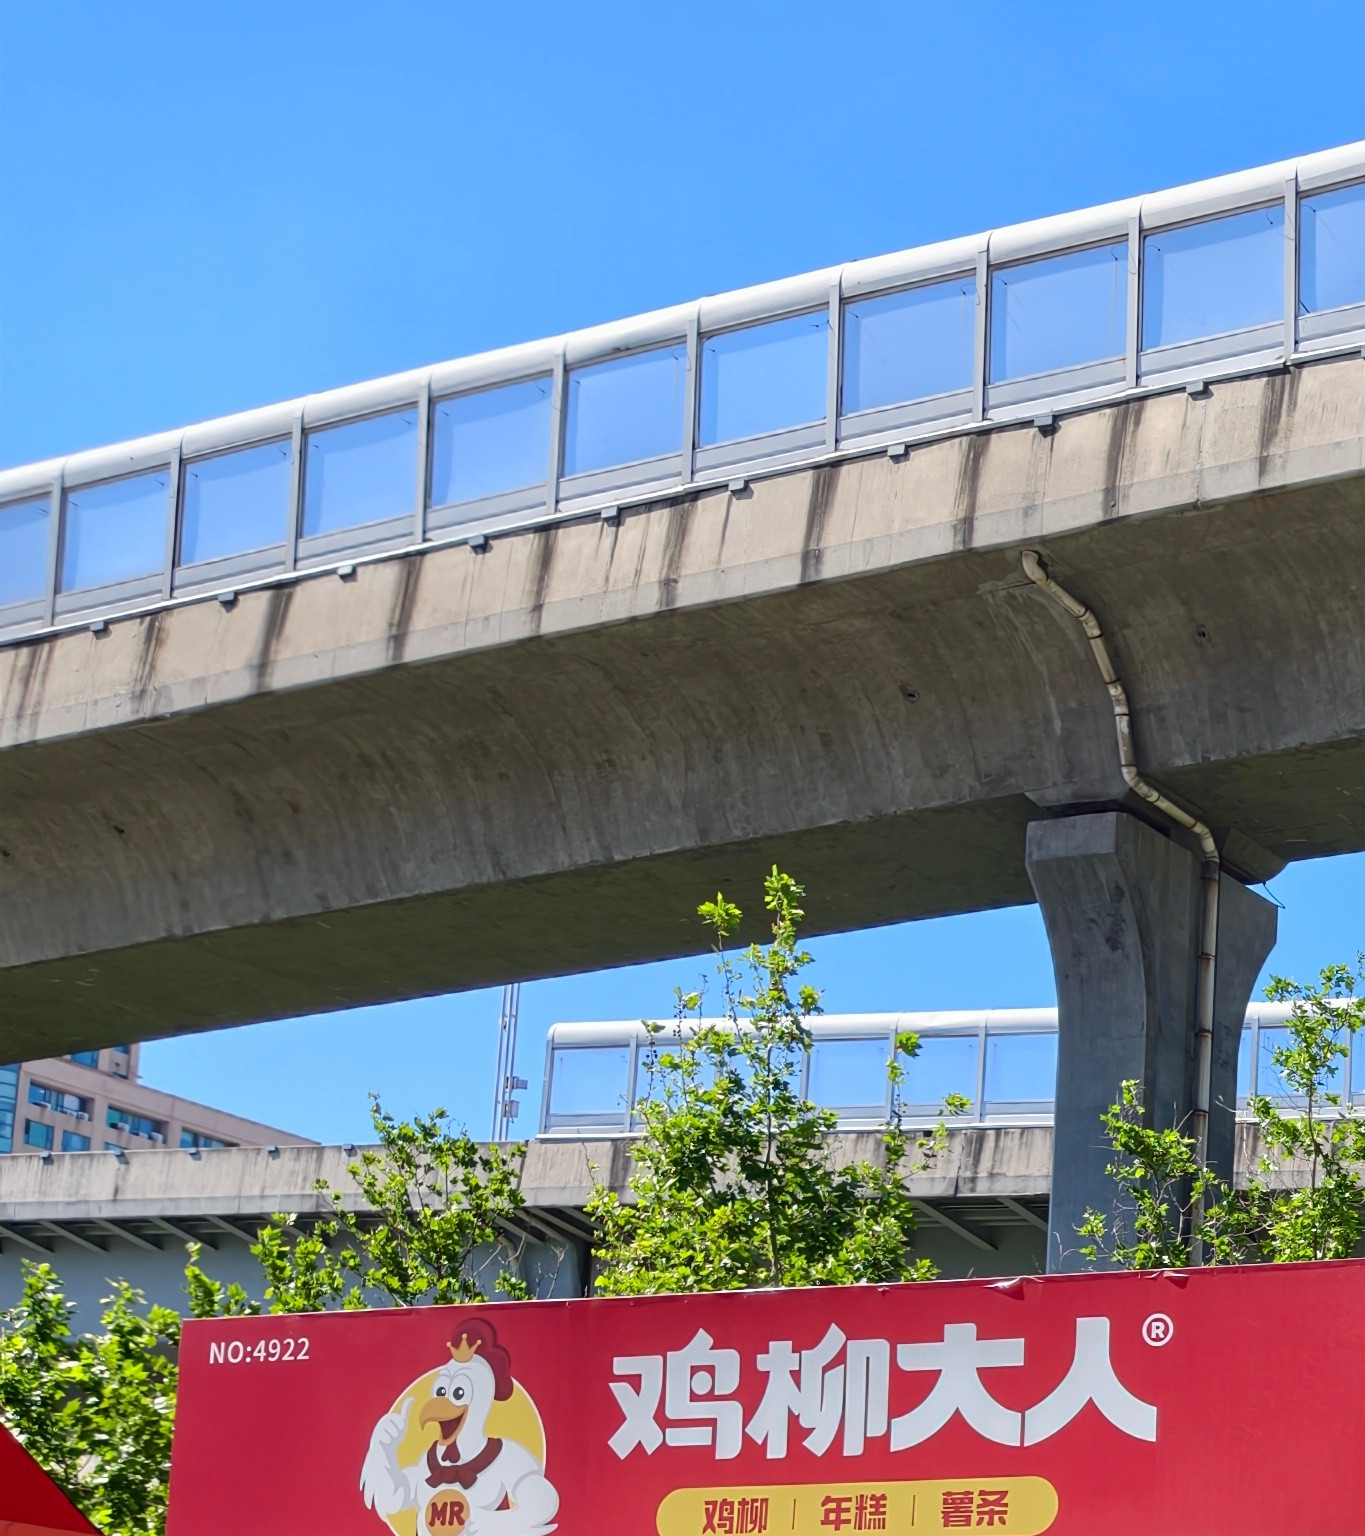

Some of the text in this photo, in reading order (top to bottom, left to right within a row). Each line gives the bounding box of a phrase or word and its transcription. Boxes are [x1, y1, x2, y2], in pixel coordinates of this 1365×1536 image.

[208, 1336, 311, 1365] NO:4922
[607, 1316, 1159, 1461] 鸡柳大人
[427, 1500, 466, 1528] MR
[701, 1489, 1010, 1535] 鸡柳 年糕 薯条
